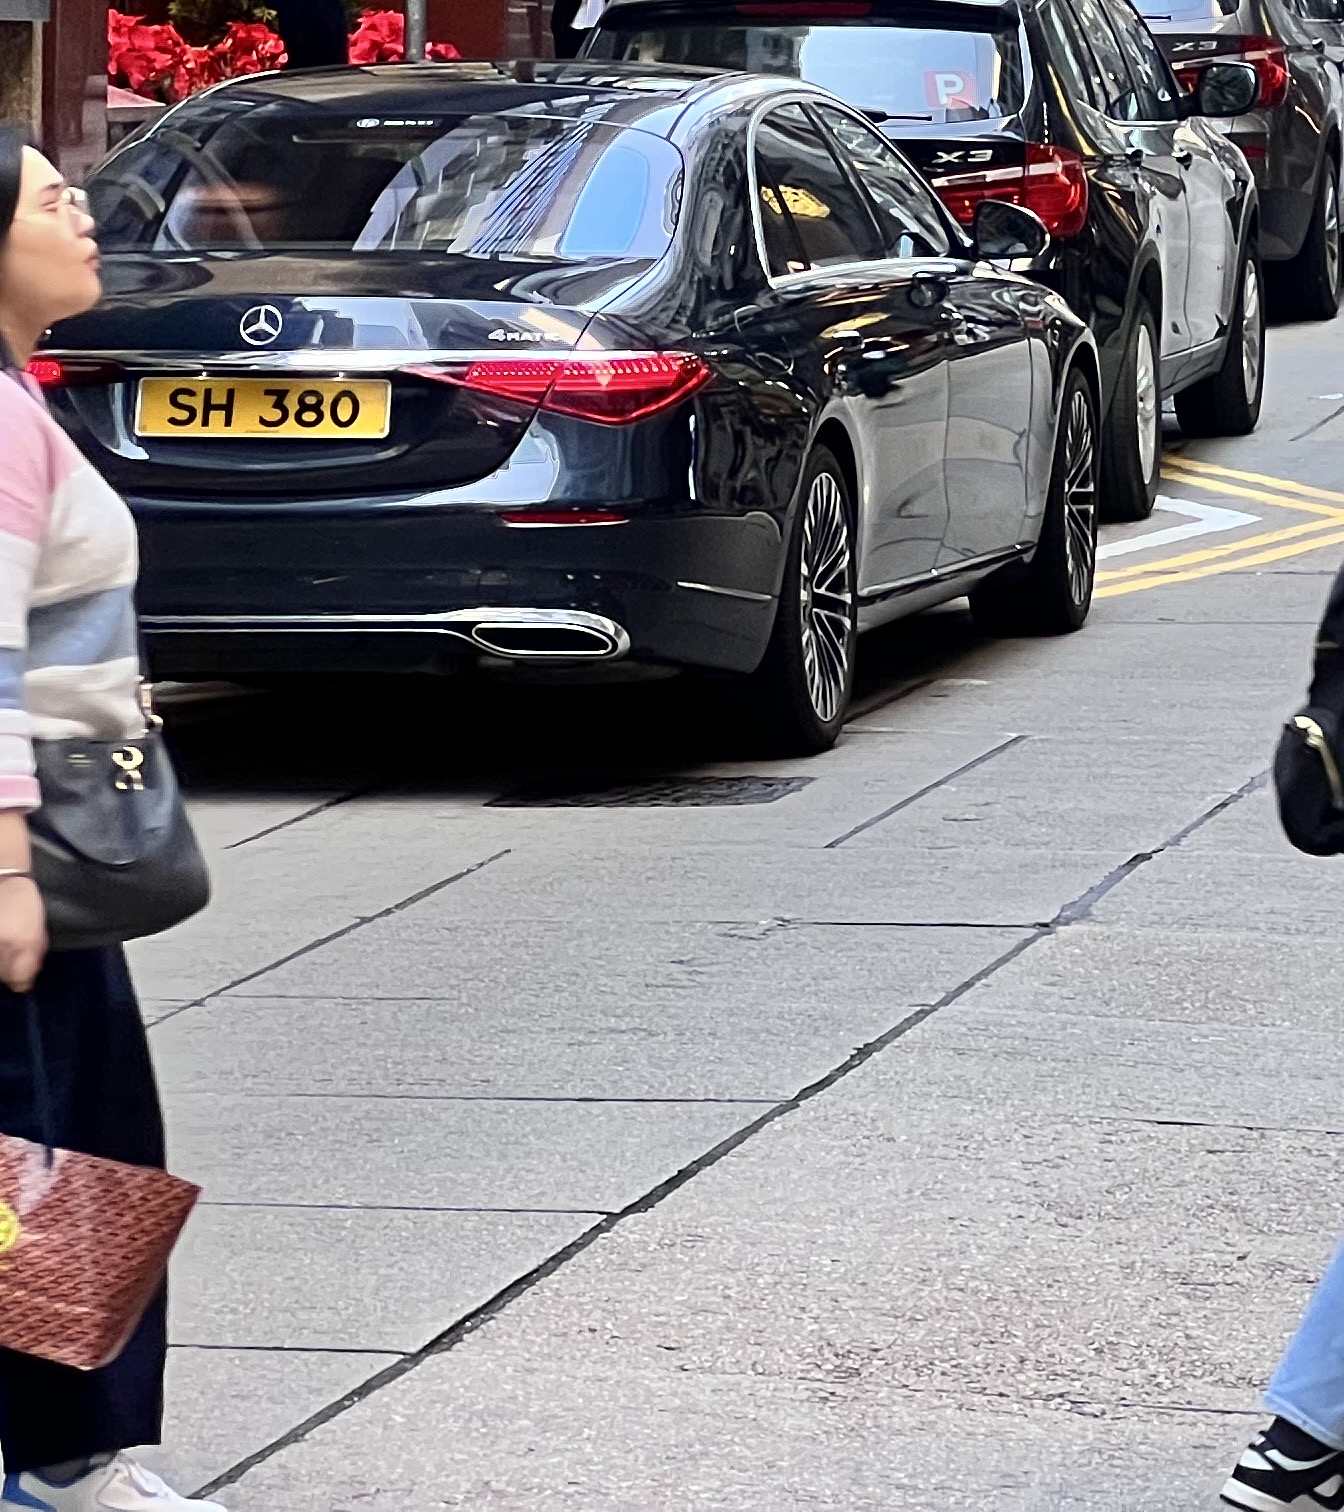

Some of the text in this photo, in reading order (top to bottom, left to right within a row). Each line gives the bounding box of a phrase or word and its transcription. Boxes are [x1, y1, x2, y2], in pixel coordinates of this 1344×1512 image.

[1172, 39, 1218, 53] X3
[935, 73, 964, 104] P
[936, 149, 994, 165] X3
[167, 387, 361, 429] SH 380
